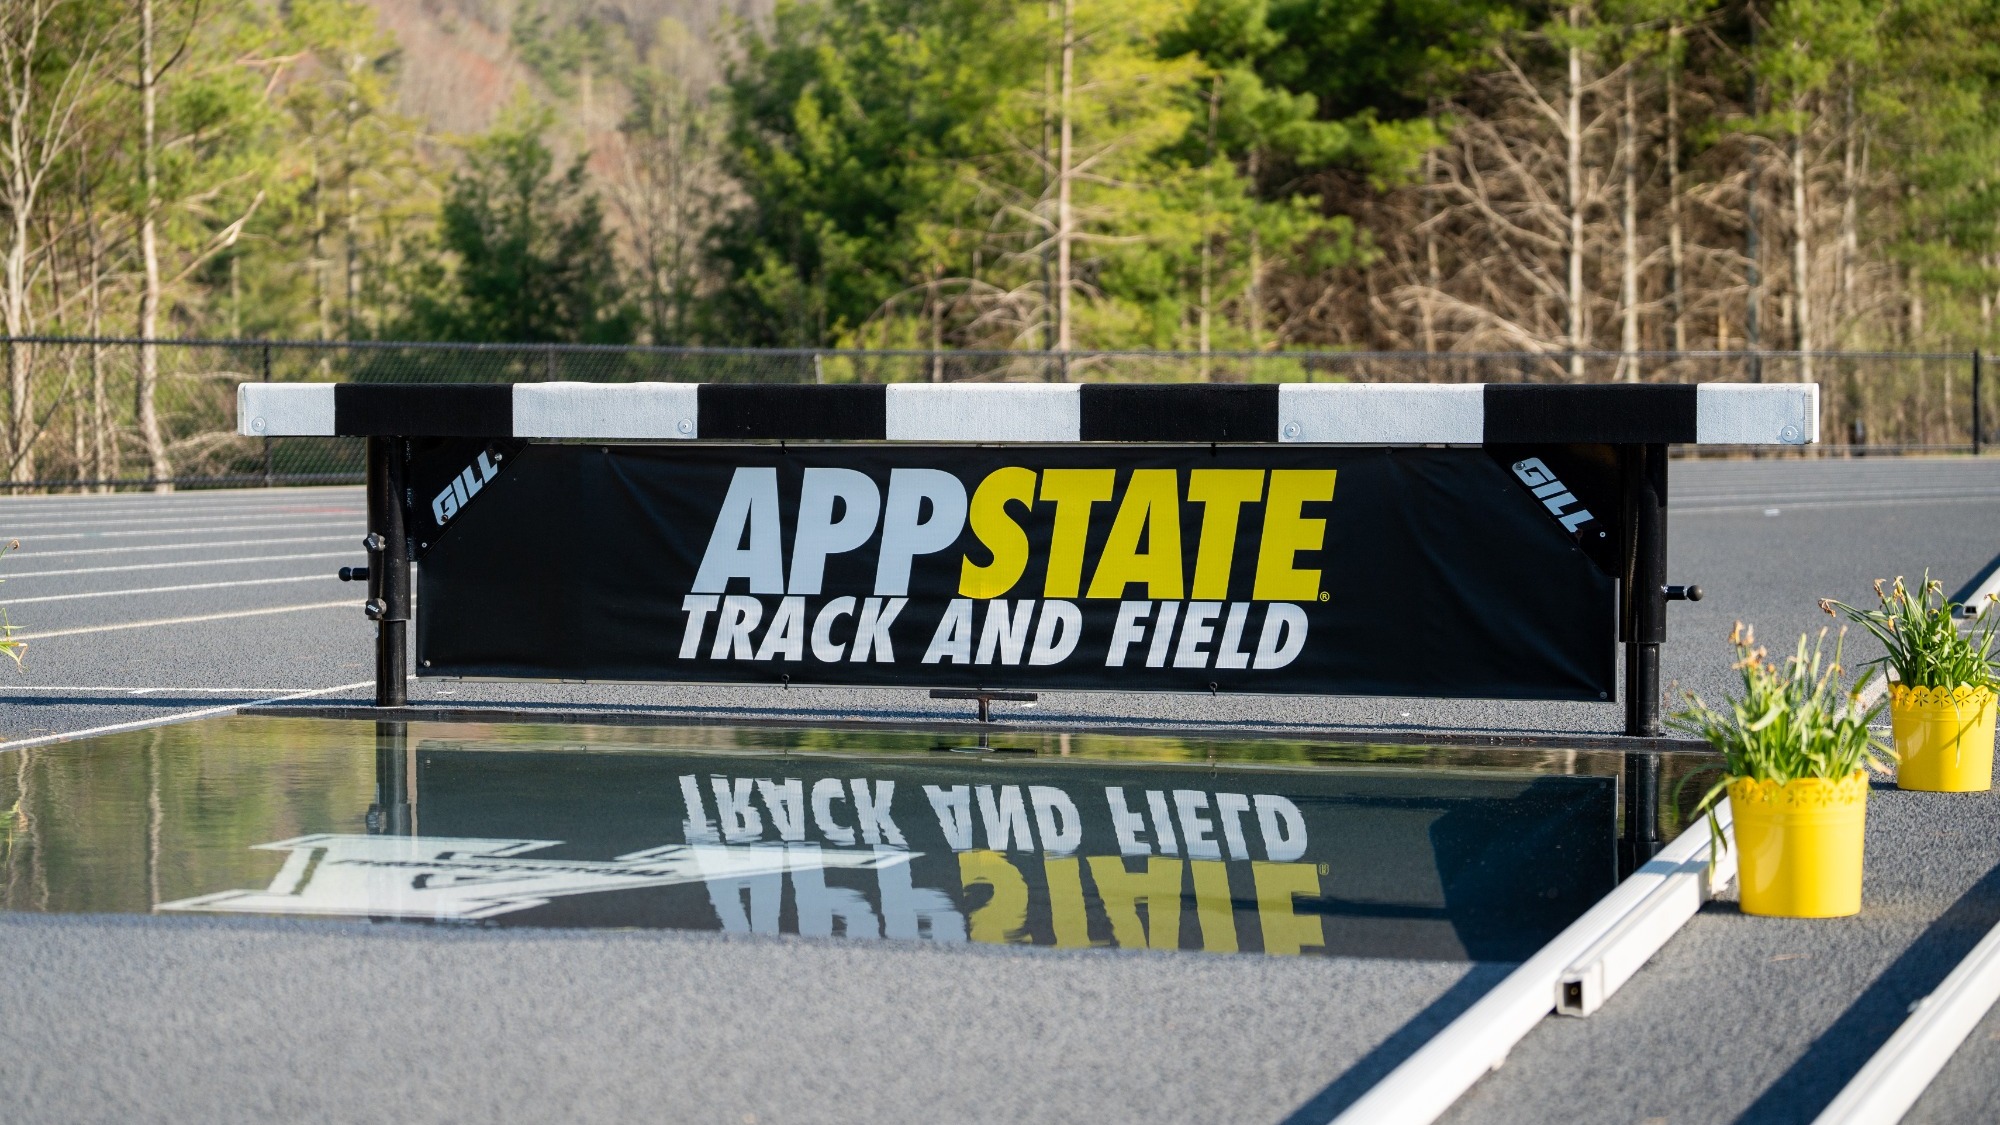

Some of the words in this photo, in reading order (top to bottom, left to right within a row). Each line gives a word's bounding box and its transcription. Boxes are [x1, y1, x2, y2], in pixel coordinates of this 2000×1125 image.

[432, 450, 498, 526] GILL
[1512, 457, 1594, 533] GILL
[678, 594, 910, 663] TRACK
[920, 598, 1083, 666] AND
[1104, 600, 1309, 670] FIELD
